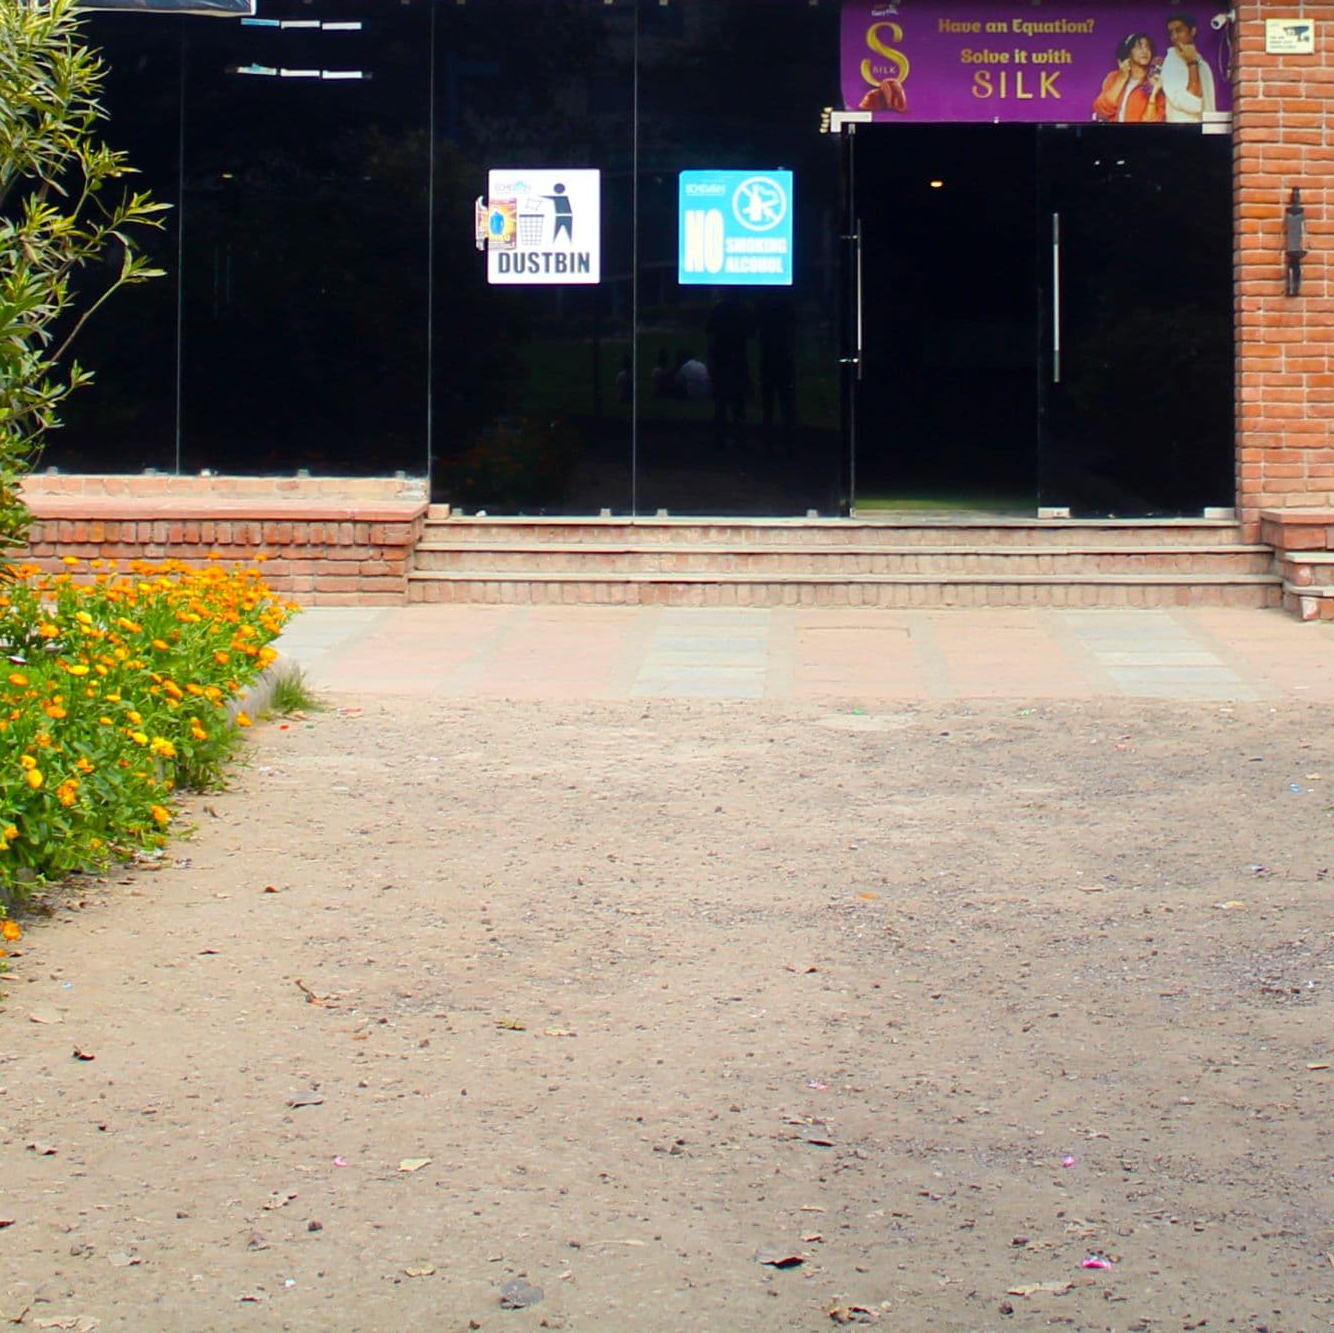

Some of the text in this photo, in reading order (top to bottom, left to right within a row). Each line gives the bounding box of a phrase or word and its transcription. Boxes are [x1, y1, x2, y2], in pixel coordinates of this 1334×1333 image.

[938, 19, 1095, 36] Have an Equation?
[961, 49, 1072, 64] Solve it with
[971, 70, 1061, 99] SILK
[685, 208, 724, 274] NO
[498, 252, 590, 274] DUSTBIN
